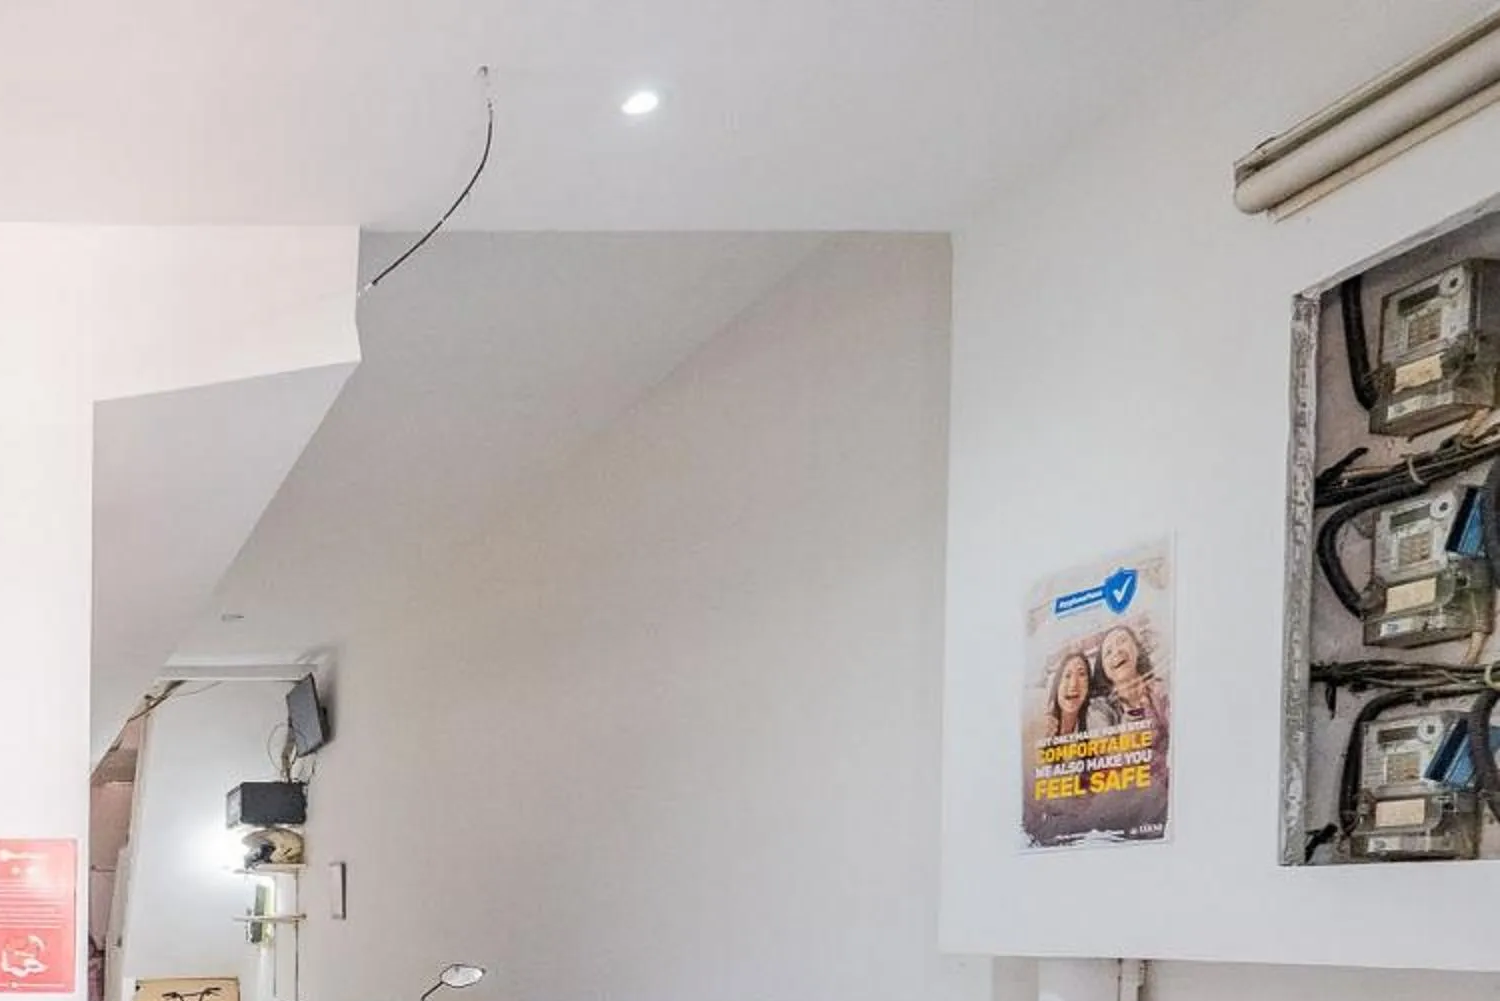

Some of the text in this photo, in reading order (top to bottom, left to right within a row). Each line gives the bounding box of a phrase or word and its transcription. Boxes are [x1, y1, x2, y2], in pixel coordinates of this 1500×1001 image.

[1037, 731, 1153, 765] COMFORTABLE
[1054, 761, 1084, 775] ALSO
[1087, 755, 1123, 771] MAKE
[1125, 749, 1153, 765] YOU
[1035, 764, 1152, 800] FEEL SAFE
